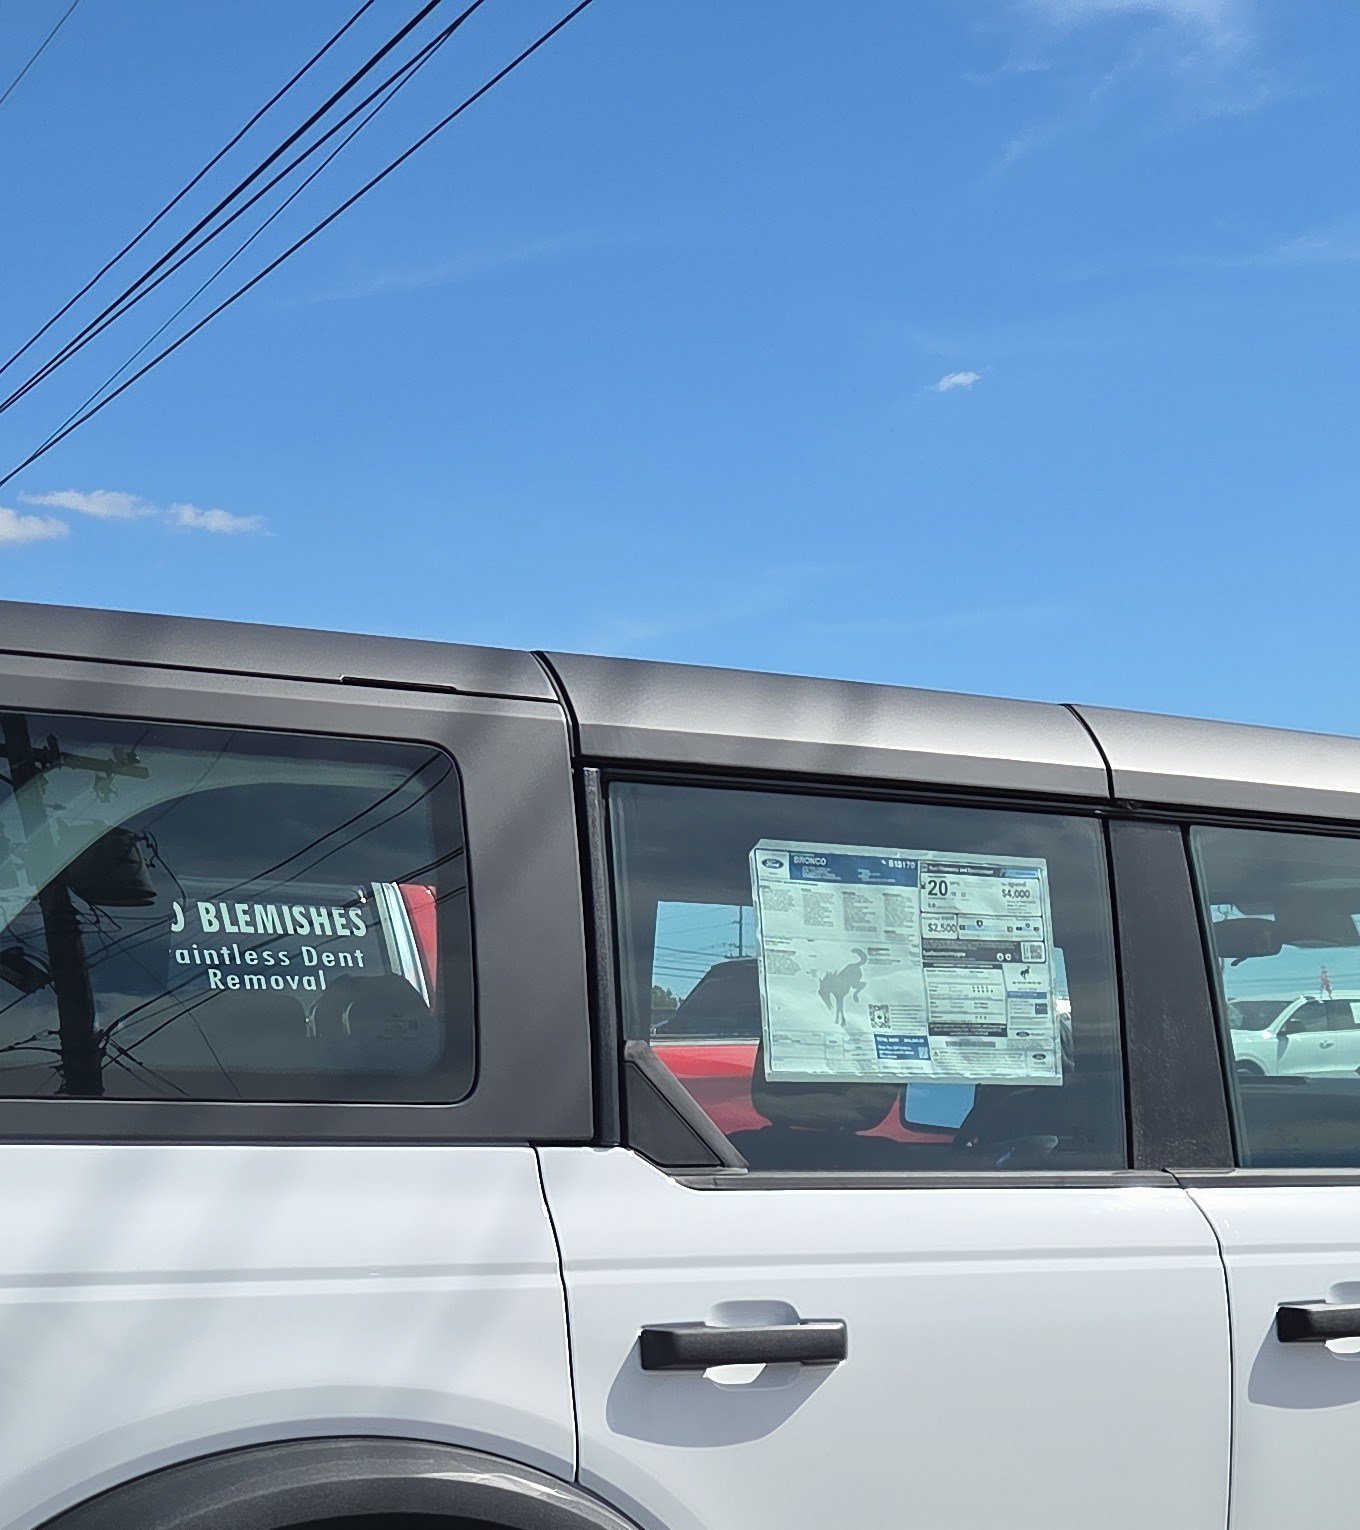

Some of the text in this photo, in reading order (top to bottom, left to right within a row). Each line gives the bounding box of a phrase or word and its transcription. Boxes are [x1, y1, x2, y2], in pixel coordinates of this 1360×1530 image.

[793, 856, 827, 866] BRONCO
[927, 879, 949, 897] 20
[1001, 888, 1031, 899] $4,000
[197, 901, 367, 937] BLEMISHES
[927, 922, 957, 933] $2,500
[169, 943, 364, 968] aintless Dent
[207, 968, 327, 991] Removal
